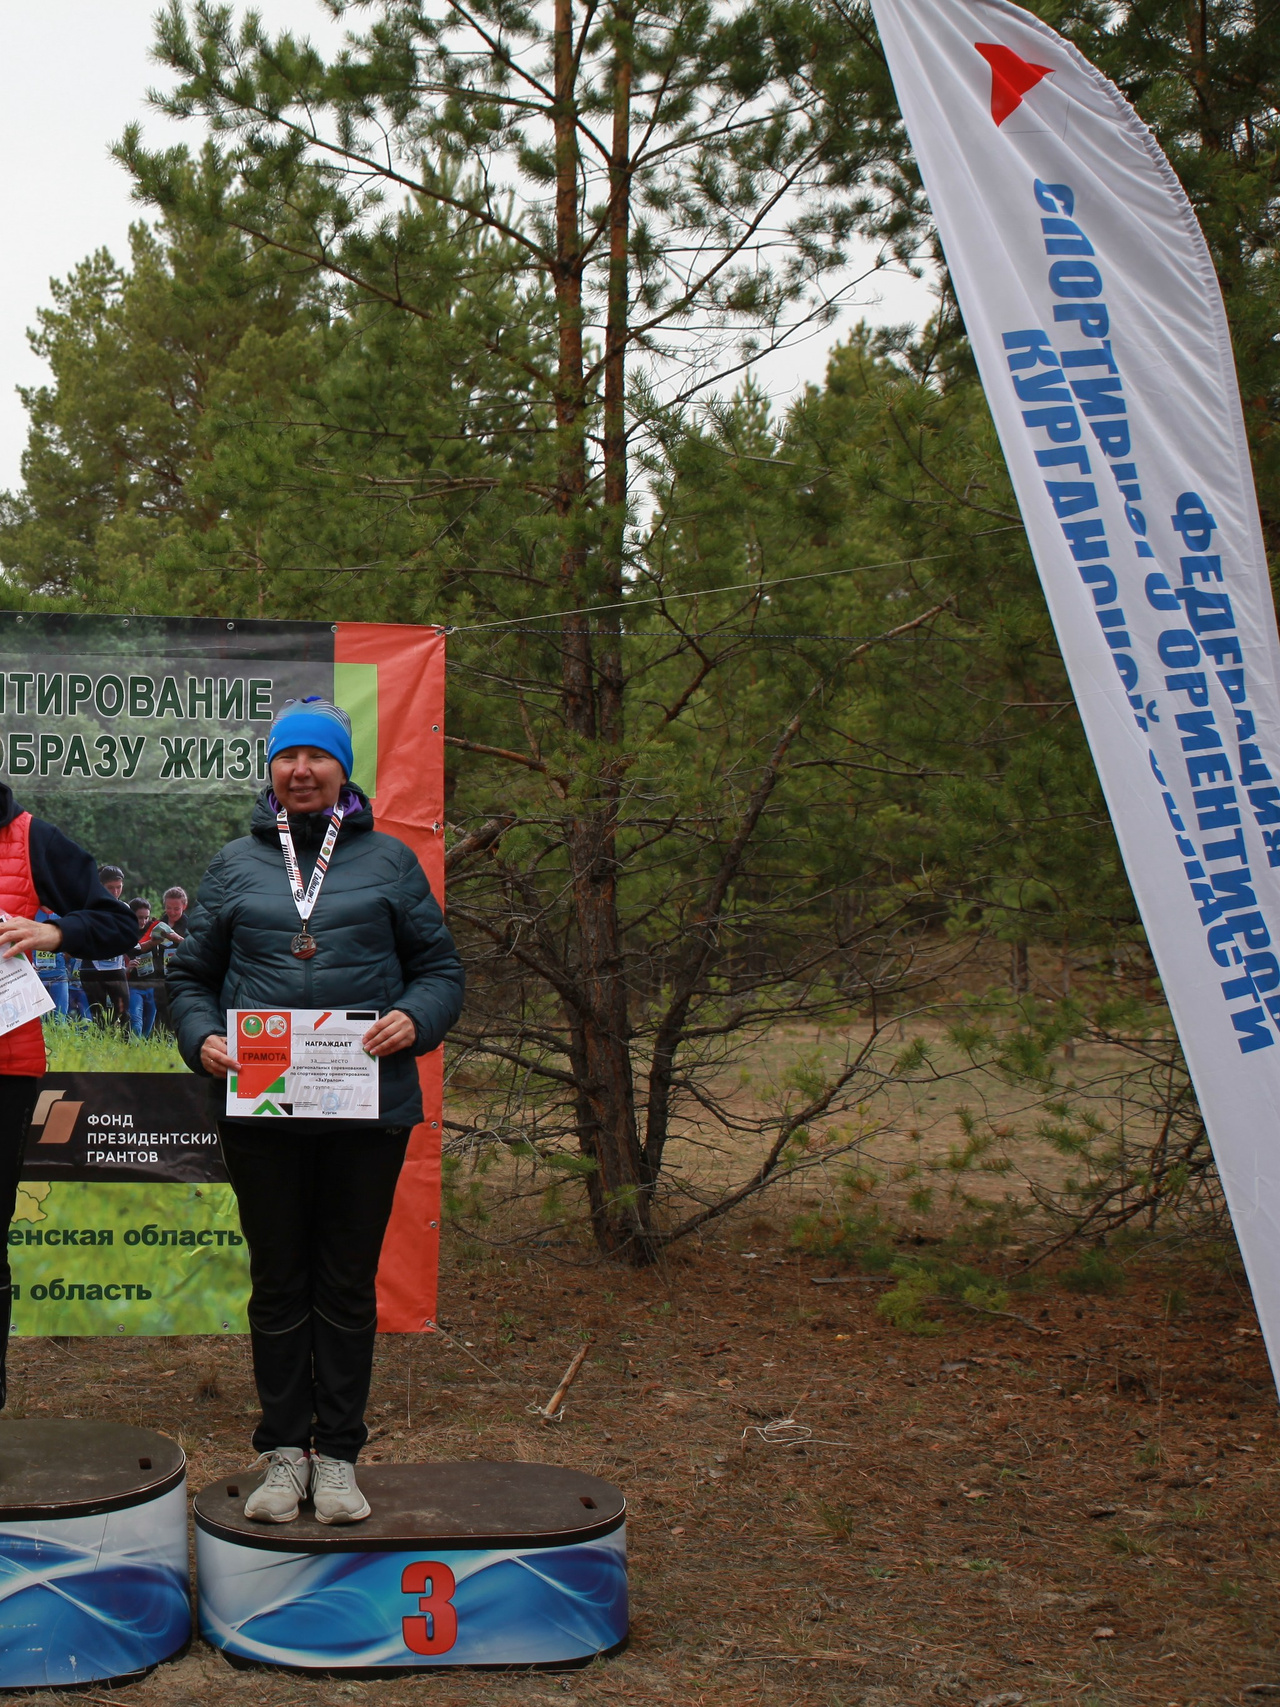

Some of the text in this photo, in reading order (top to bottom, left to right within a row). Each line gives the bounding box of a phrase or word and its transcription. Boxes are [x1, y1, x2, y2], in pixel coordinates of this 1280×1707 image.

[160, 736, 270, 781] ЖИЗ
[242, 1052, 287, 1061] ГРАМОТА
[87, 1114, 134, 1128] ФОНД
[87, 1151, 159, 1163] ГРАНТОВ
[124, 1224, 243, 1247] область
[30, 1278, 152, 1301] область
[401, 1561, 458, 1655] 3
